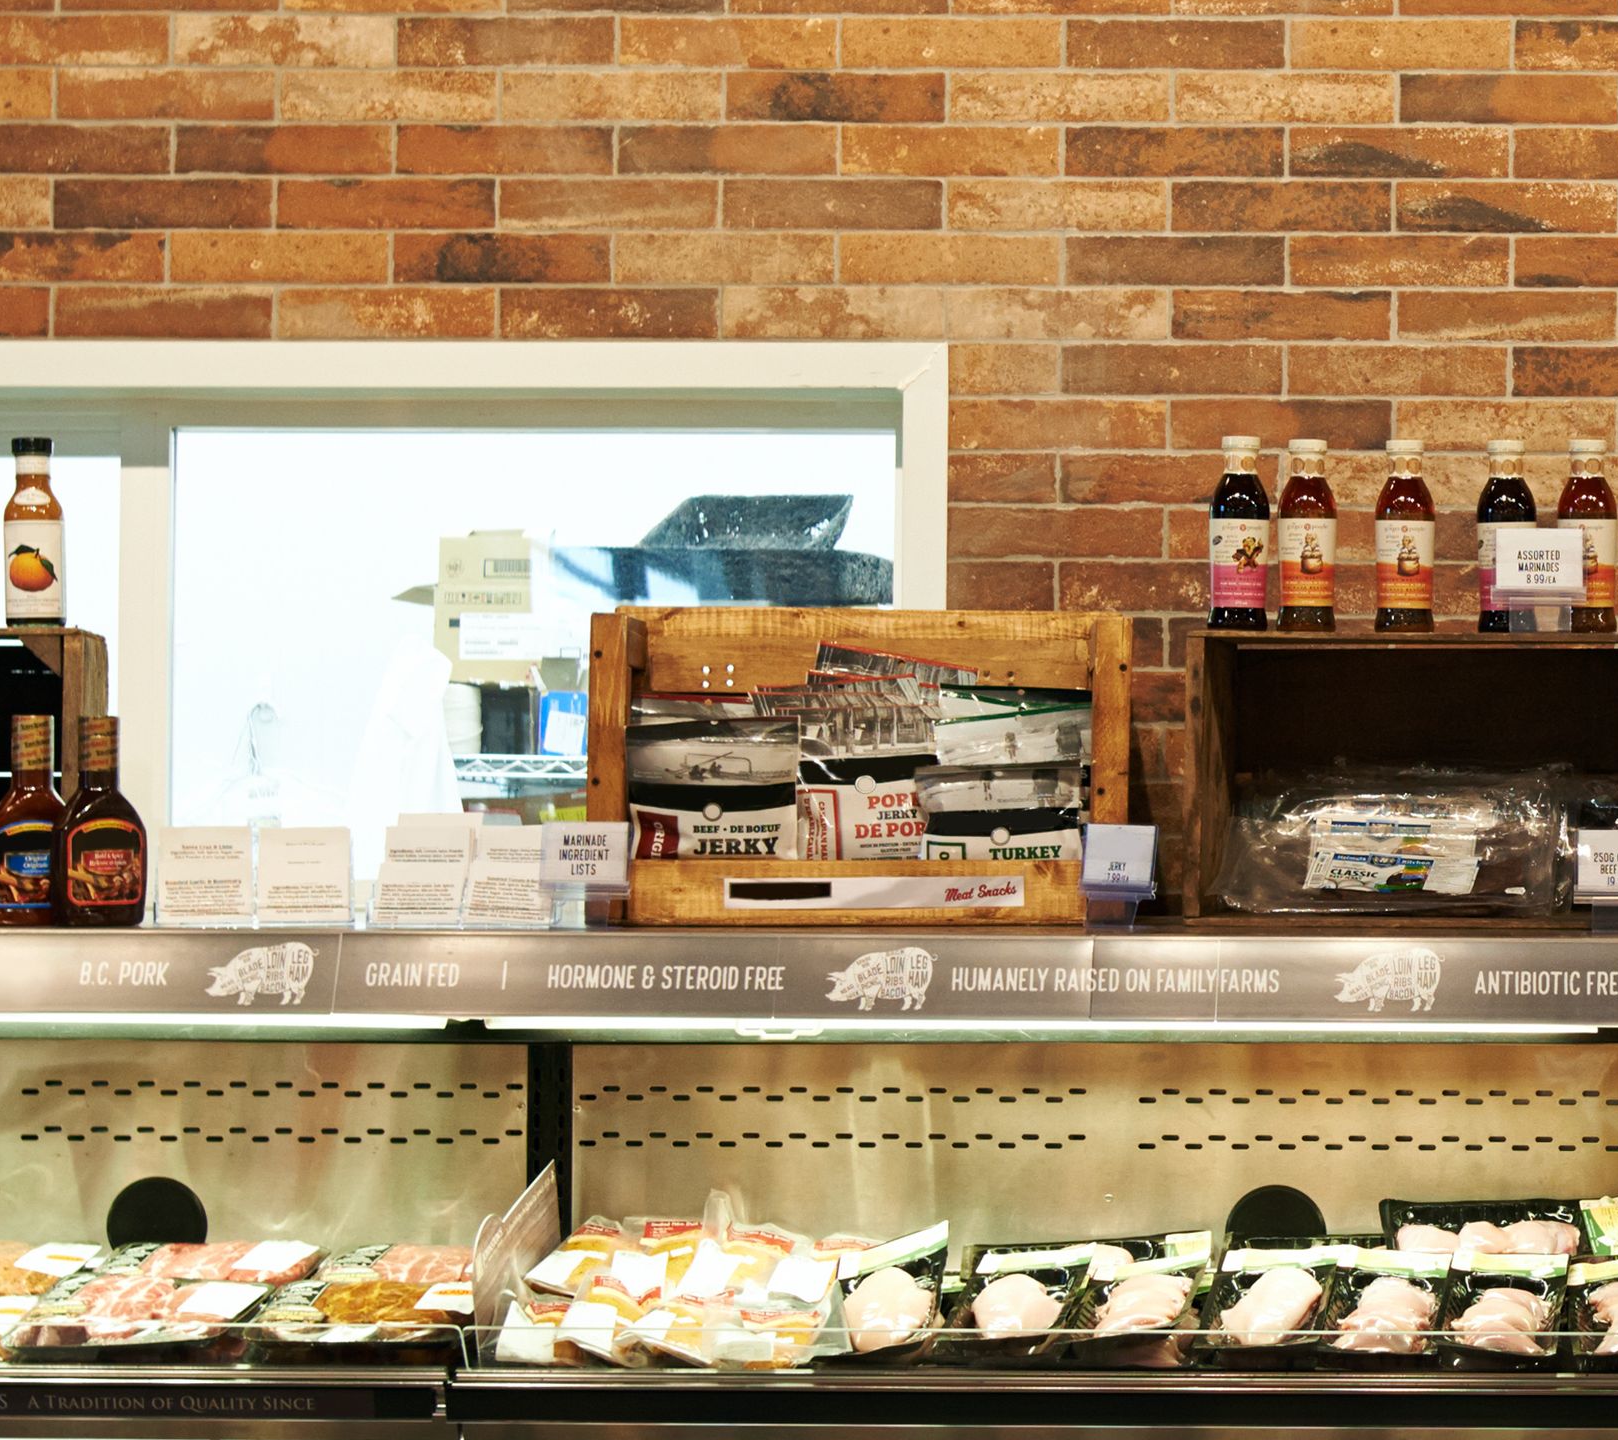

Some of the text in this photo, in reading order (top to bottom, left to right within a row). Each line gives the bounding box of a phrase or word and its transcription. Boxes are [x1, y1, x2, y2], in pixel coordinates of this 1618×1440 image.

[1517, 550, 1560, 560] ASSORTED
[1518, 562, 1560, 572] MARINADES
[876, 809, 918, 820] JERKY
[693, 823, 780, 834] BEEF DE BOEUF
[854, 821, 883, 839] DE
[563, 834, 607, 847] MARINADE
[693, 837, 779, 855] JERKY
[558, 849, 608, 862] INGREDIENT
[989, 845, 1062, 860] TURKEY
[1593, 853, 1615, 863] 250G
[570, 863, 596, 876] LISTS
[1108, 862, 1126, 872] JERKY
[1600, 864, 1617, 874] BEEF
[944, 881, 1017, 902] Meat Snacks
[80, 961, 168, 986] B.C. PORK
[365, 962, 460, 987] GRAIN FED
[547, 964, 785, 990] HORMONE & STEROID FREE
[908, 970, 928, 986] HAM
[951, 966, 1280, 994] HUMANELY RAISED ON FAMILY FARMS
[1475, 970, 1581, 996] ANTIBIOTIC
